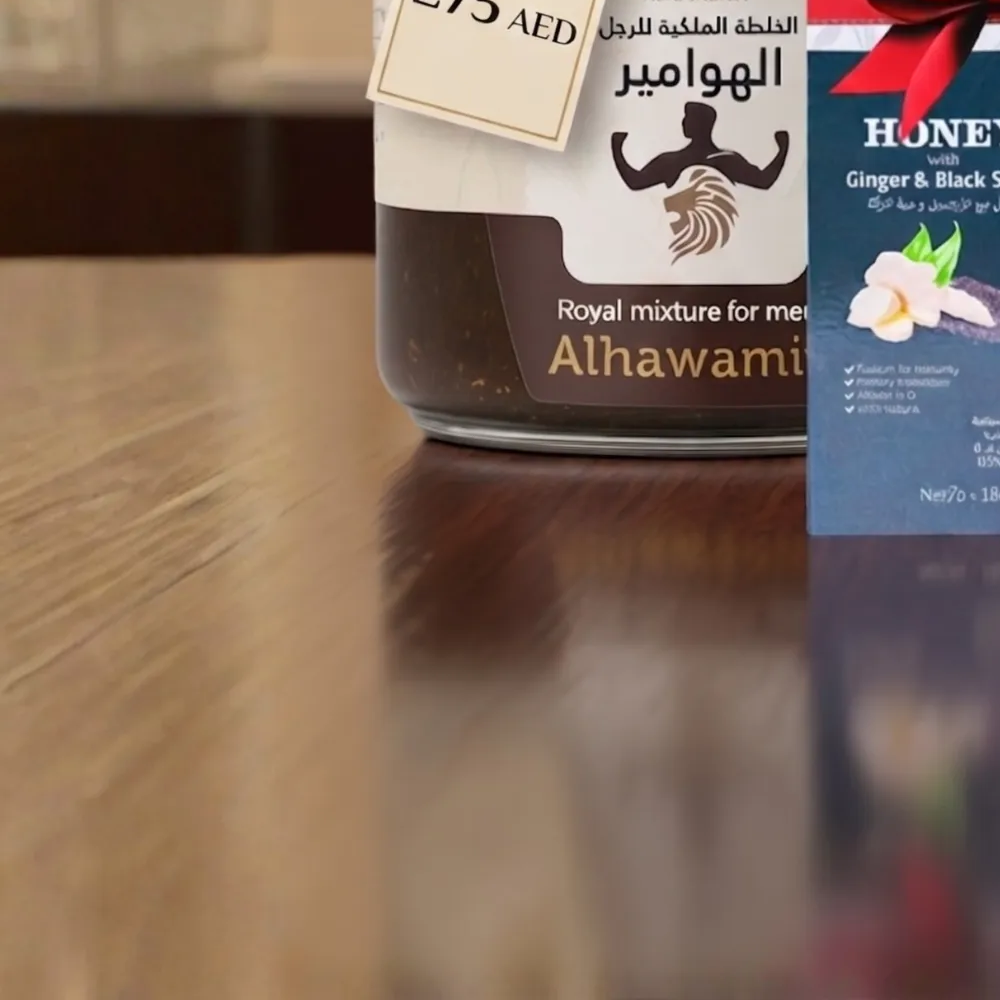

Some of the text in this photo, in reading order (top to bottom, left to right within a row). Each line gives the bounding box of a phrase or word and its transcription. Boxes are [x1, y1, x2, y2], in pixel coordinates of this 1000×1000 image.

[507, 8, 578, 45] AED
[599, 15, 798, 41] الخلطة الملكية للرجل
[614, 46, 782, 102] الهوامير
[927, 153, 960, 166] with
[846, 170, 910, 193] Ginger
[914, 171, 929, 188] &
[935, 170, 986, 188] Black
[557, 298, 622, 325] Royal
[630, 298, 721, 322] mixture
[727, 299, 759, 322] for
[547, 333, 808, 378] Alhawami
